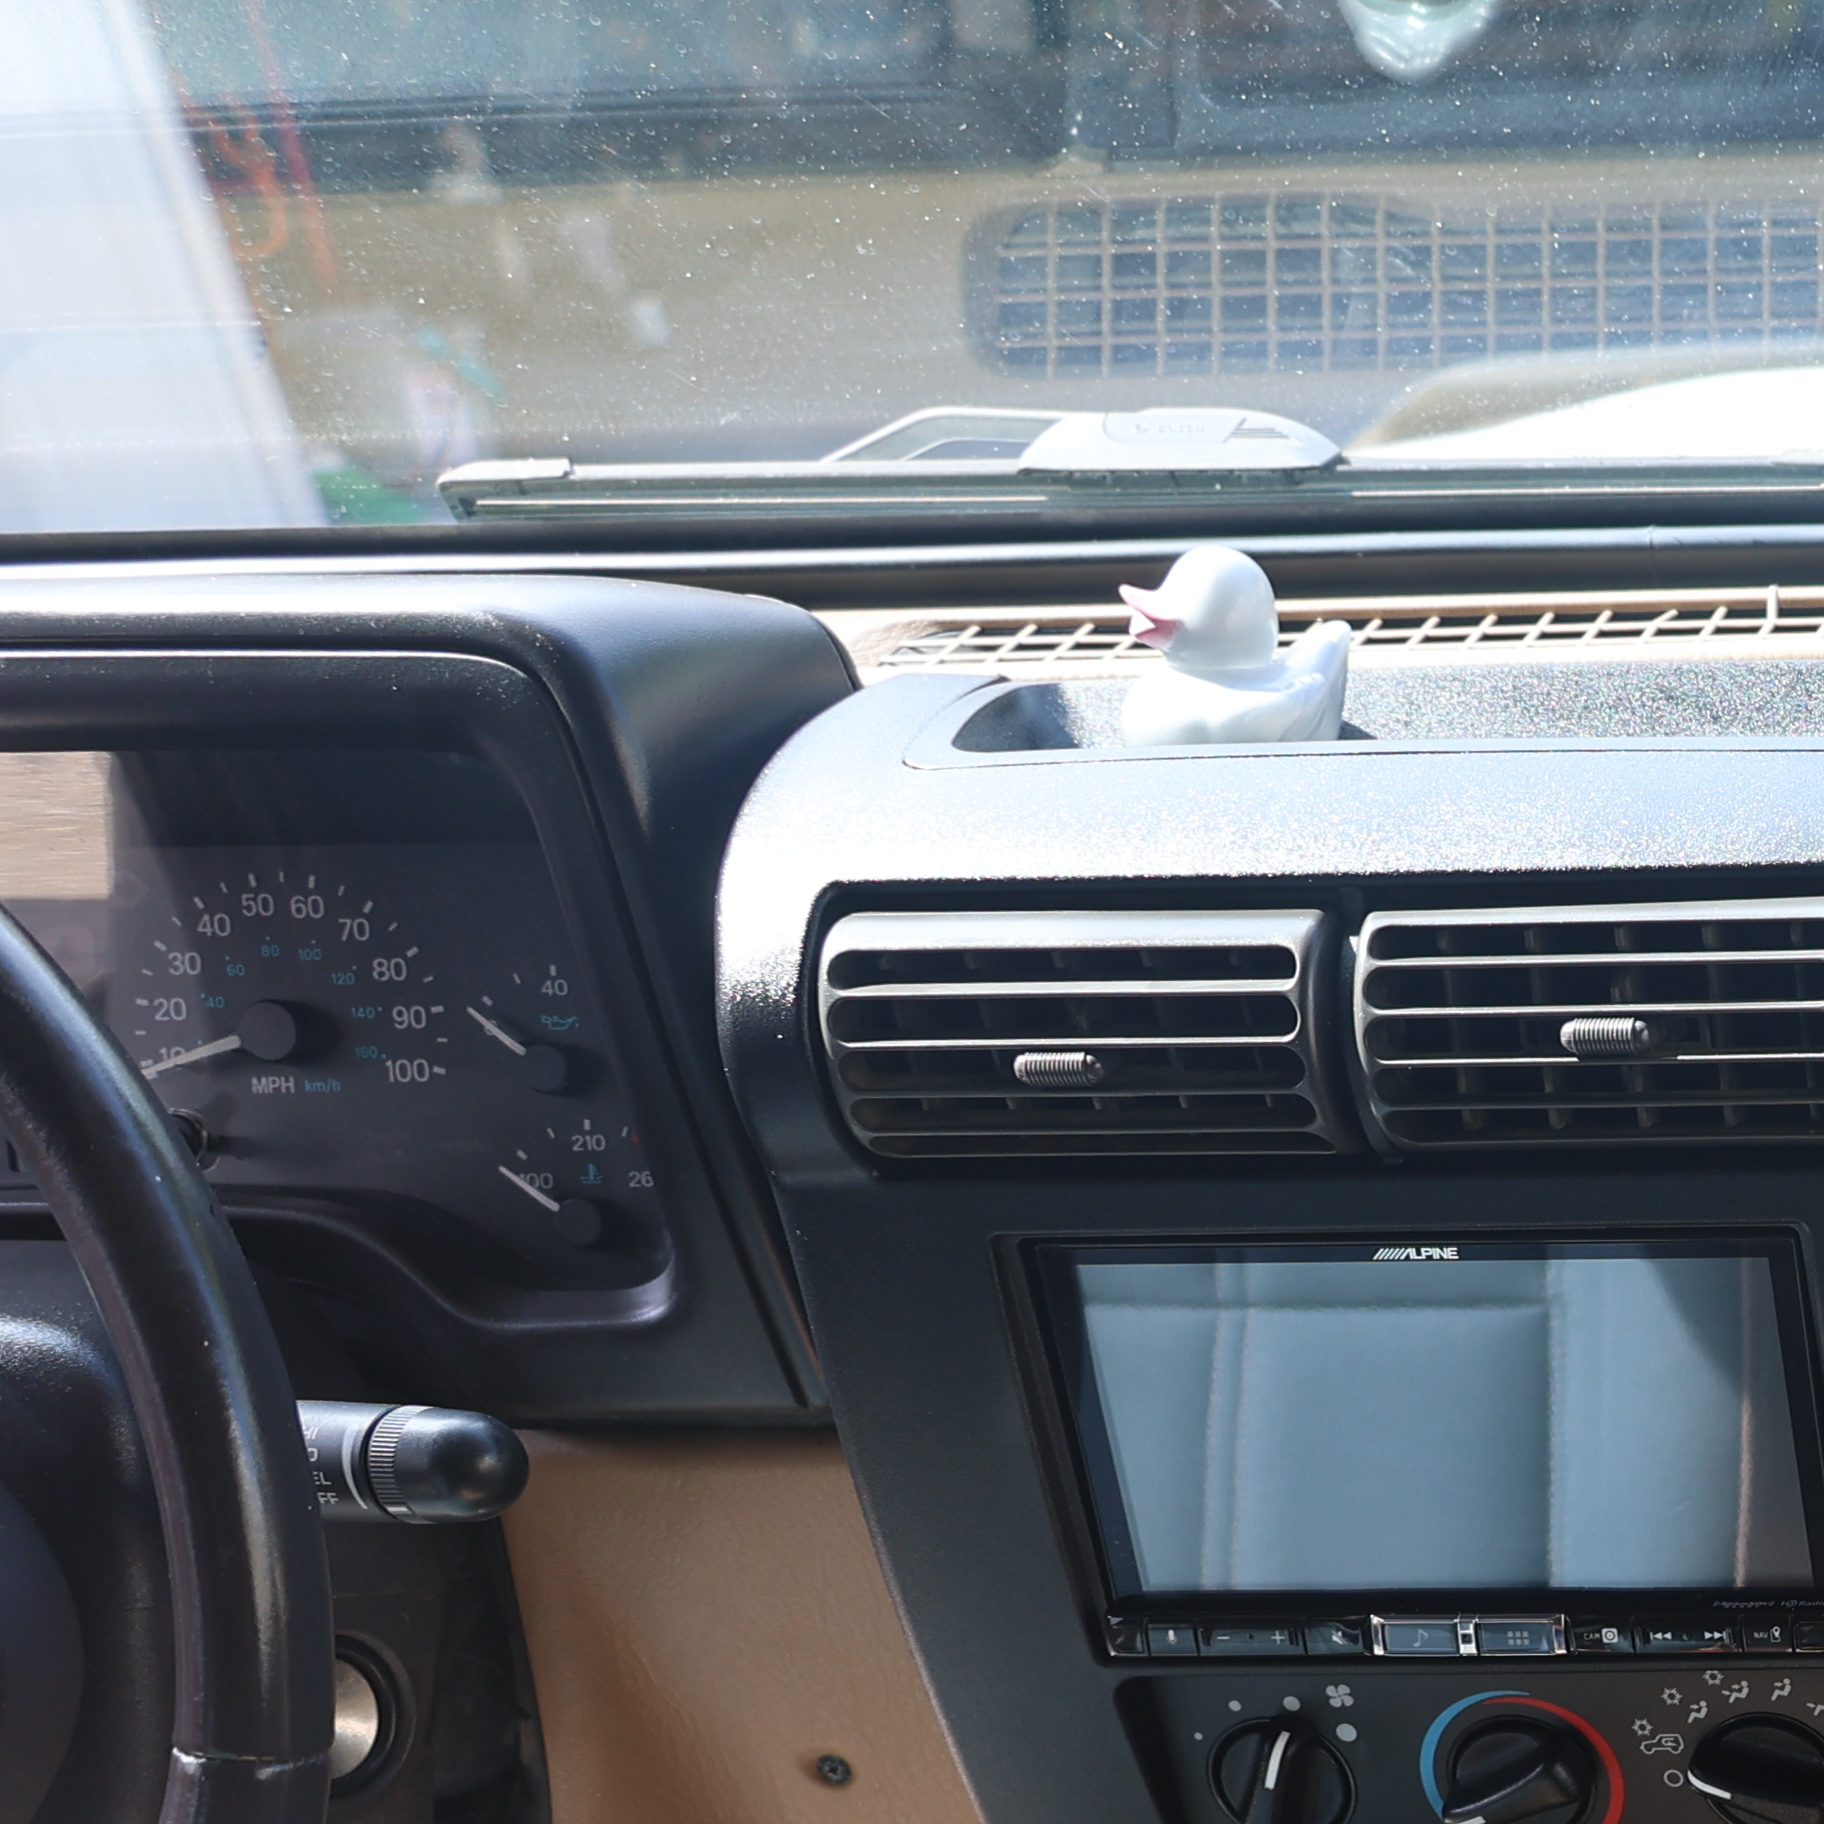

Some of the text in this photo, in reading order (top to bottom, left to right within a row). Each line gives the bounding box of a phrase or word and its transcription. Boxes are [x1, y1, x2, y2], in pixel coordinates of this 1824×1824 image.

[241, 893, 274, 917] 50
[290, 895, 324, 918] 60
[197, 914, 231, 936] 40
[338, 918, 370, 941] 70
[261, 945, 279, 957] 80
[298, 949, 322, 961] 100
[167, 951, 201, 975] 30
[226, 964, 245, 976] 60
[372, 958, 407, 981] 80
[331, 973, 355, 985] 120
[541, 979, 568, 997] 40
[153, 998, 187, 1021] 20
[206, 996, 225, 1008] 40
[351, 1007, 375, 1019] 140
[392, 1005, 427, 1029] 90
[354, 1046, 378, 1058] 160
[385, 1059, 430, 1083] 100
[251, 1077, 341, 1094] MPH km/h
[571, 1134, 606, 1151] 210
[1398, 1247, 1460, 1260] ALPINE
[317, 1492, 340, 1504] FF
[1583, 1632, 1601, 1641] CAM
[1753, 1632, 1769, 1640] NAV
